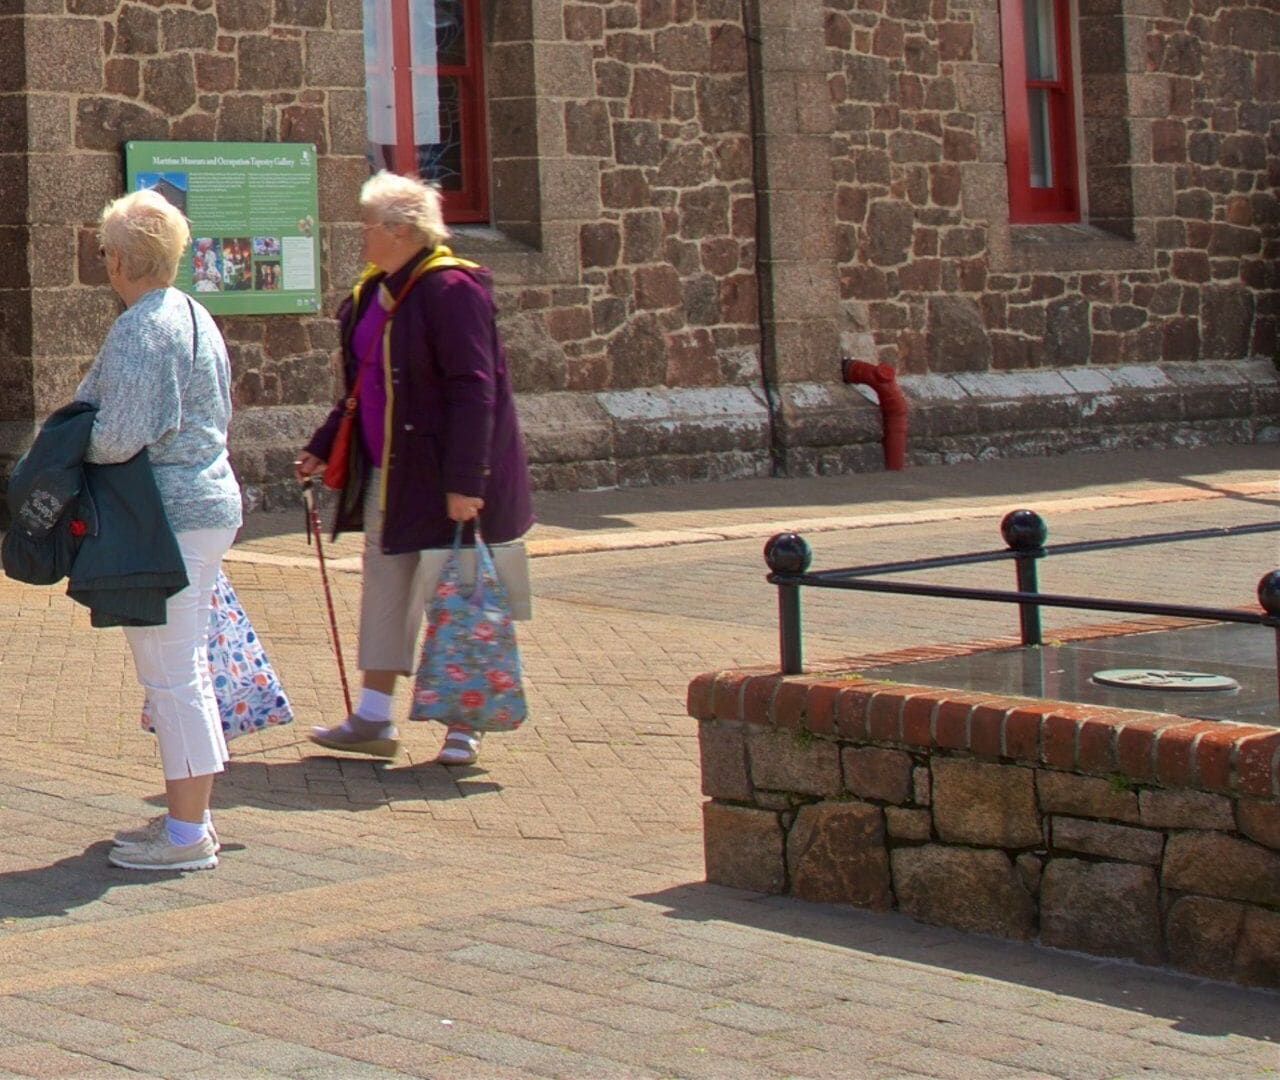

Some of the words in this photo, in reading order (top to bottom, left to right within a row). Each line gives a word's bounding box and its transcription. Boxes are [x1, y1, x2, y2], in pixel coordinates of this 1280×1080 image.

[152, 156, 180, 165] Maritime
[180, 157, 206, 166] Museum
[207, 156, 217, 166] and
[218, 157, 250, 168] Occupation
[250, 157, 274, 168] Tapestry
[274, 157, 295, 168] Gallery
